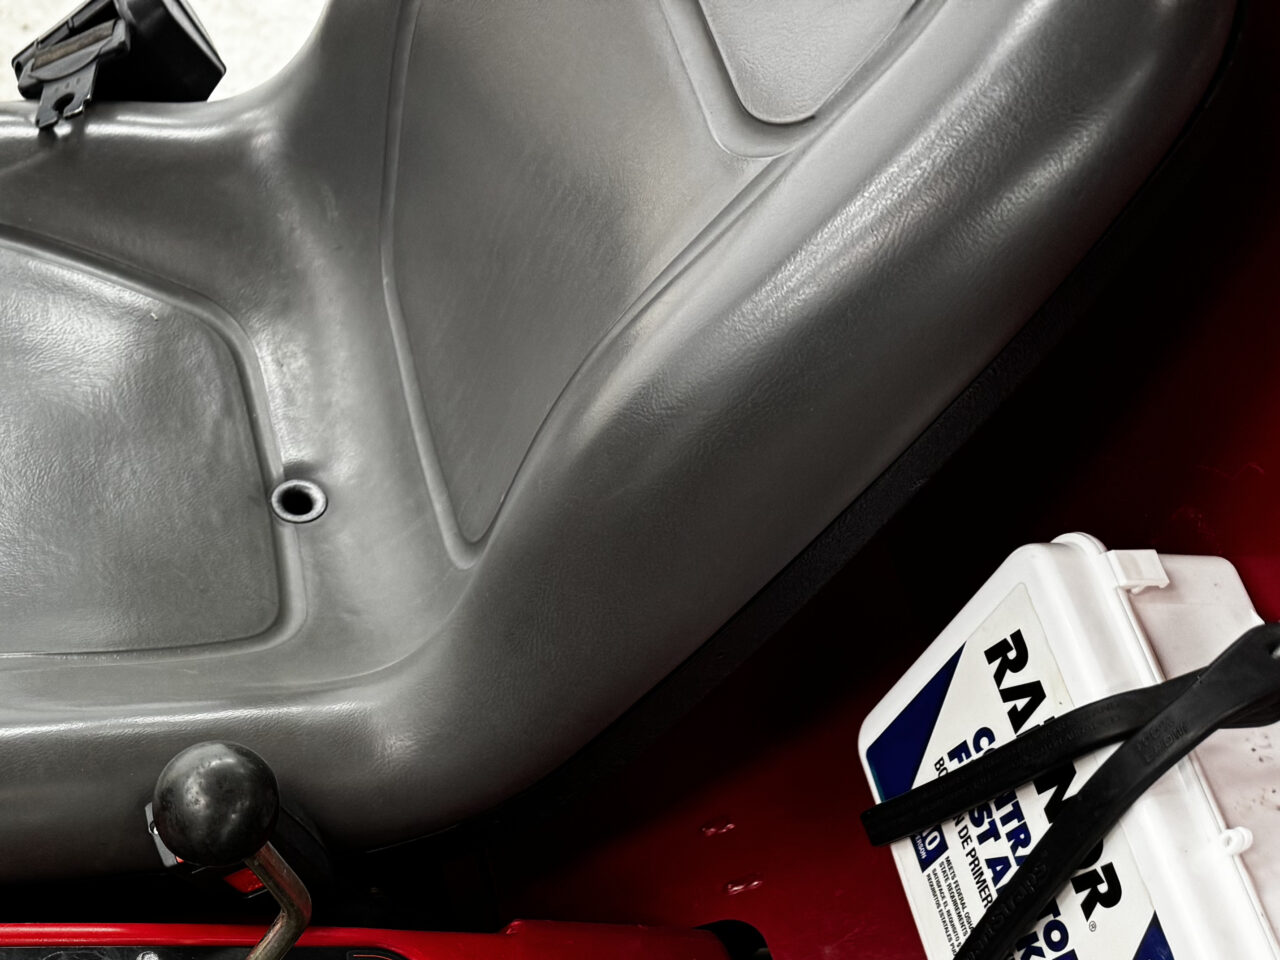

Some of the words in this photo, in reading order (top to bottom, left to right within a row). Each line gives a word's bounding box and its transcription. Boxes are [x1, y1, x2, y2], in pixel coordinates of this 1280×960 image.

[947, 739, 1001, 845] FST
[984, 629, 1122, 921] RANR
[915, 835, 926, 858] ERSON
[945, 856, 956, 880] MEETS
[953, 880, 967, 912] FEDERAL
[958, 825, 972, 849] DE
[966, 847, 993, 909] PRIMER
[939, 861, 950, 883] STATE
[947, 883, 970, 936] REQUIREMENTS
